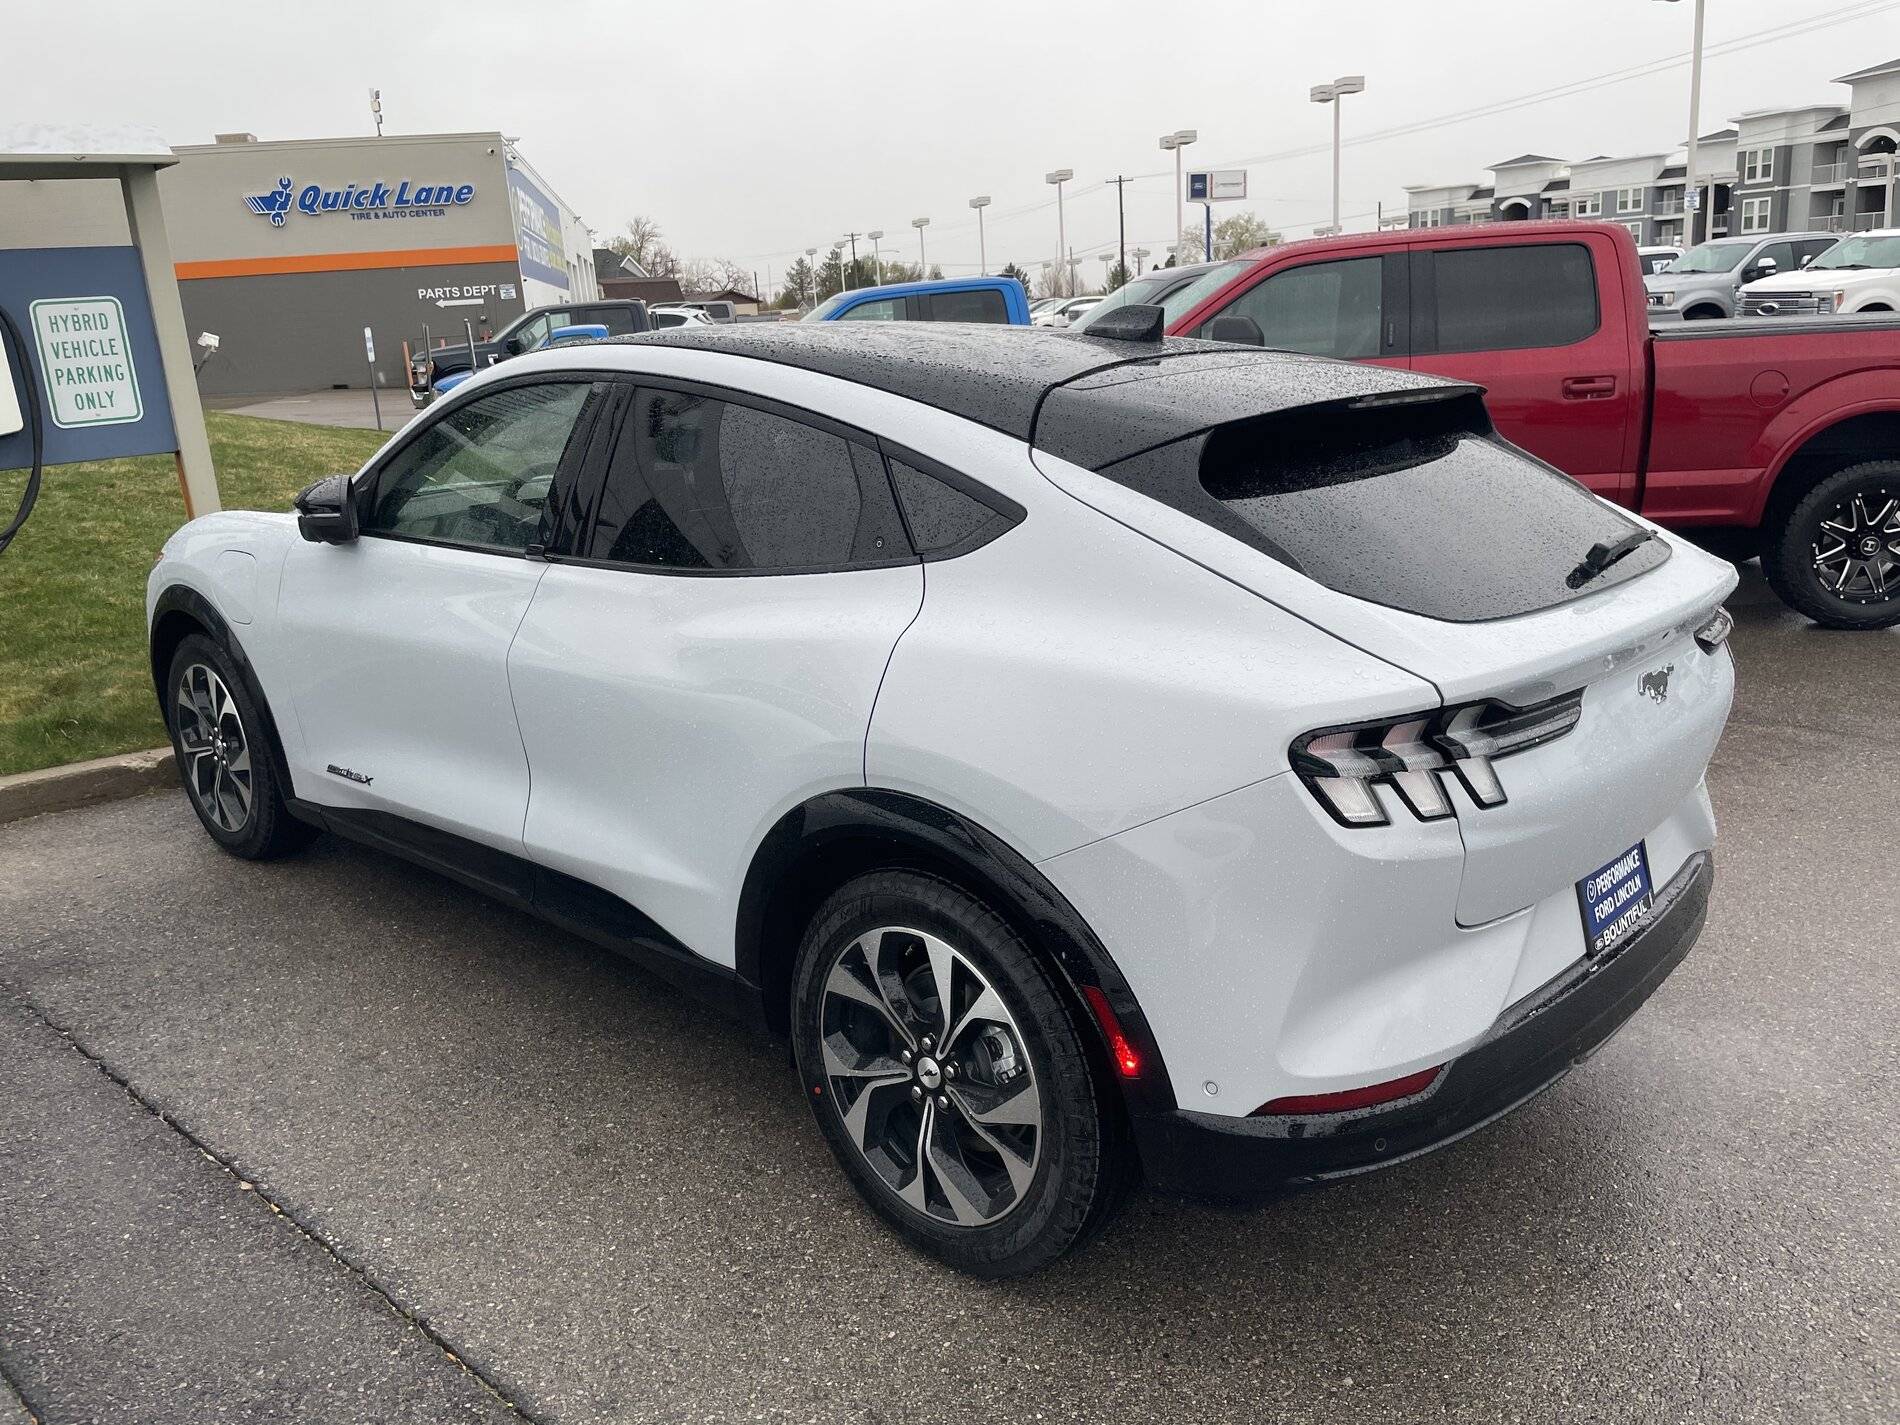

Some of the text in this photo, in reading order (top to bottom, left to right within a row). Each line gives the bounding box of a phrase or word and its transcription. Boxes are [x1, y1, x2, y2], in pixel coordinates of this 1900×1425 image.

[298, 177, 475, 215] Quick Lane
[351, 208, 446, 221] TIRE & AUTO CENTER
[417, 287, 461, 299] PARTS
[463, 284, 497, 297] DEPT
[48, 312, 109, 333] HYBRID
[50, 338, 119, 360] VEHICLE
[54, 364, 125, 386] PARKING
[74, 390, 115, 411] ONLY
[1595, 848, 1640, 896] PERFORMANCE
[1594, 874, 1642, 923] FORD LINCOLN
[1603, 899, 1648, 946] BOUNTIFUL
